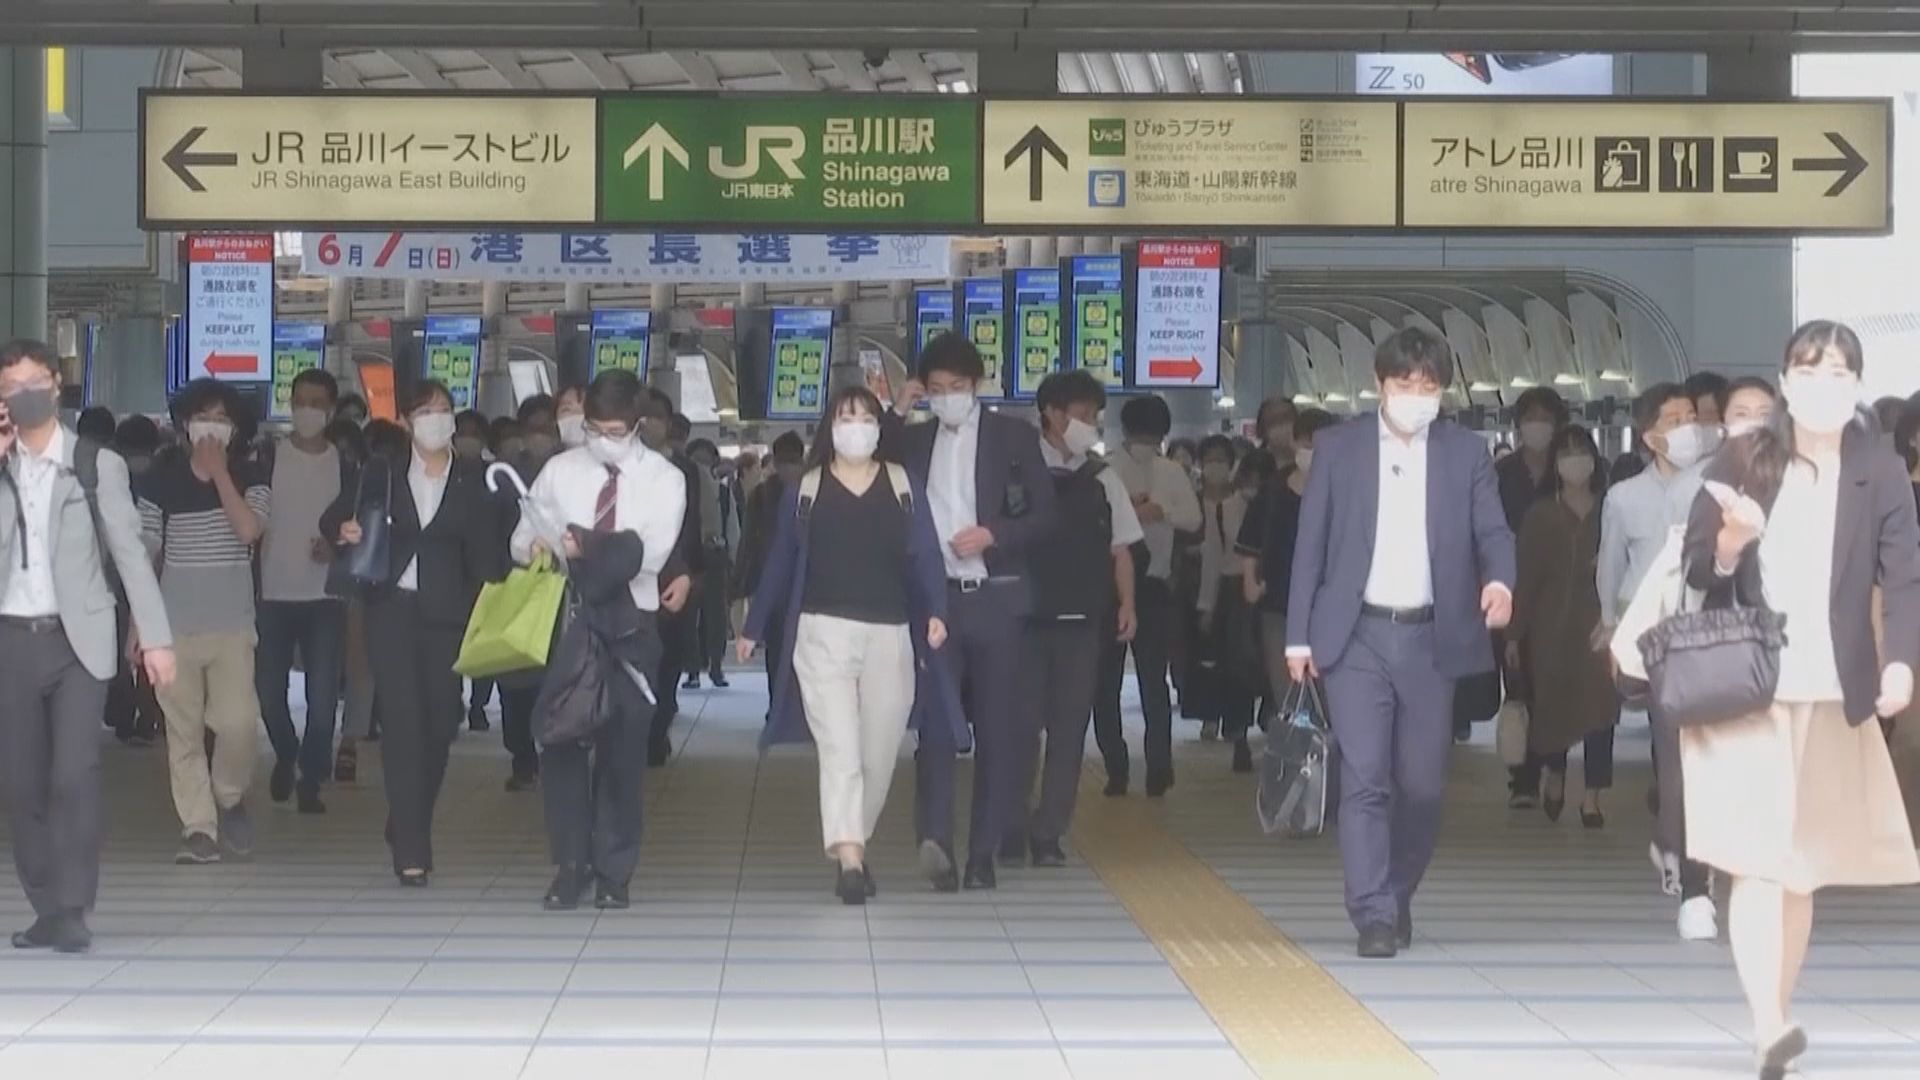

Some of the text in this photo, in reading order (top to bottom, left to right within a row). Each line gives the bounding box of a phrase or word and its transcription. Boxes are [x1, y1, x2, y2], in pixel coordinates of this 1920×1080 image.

[1403, 73, 1425, 90] 50
[822, 117, 935, 155] 品川駅
[1134, 118, 1235, 137] びゅうプラザ
[251, 131, 571, 165] JR 品川イーストビル
[708, 125, 806, 180] JR
[1223, 141, 1256, 151] Service
[1258, 141, 1288, 151] Center
[1430, 137, 1584, 169] アトレ品川
[251, 170, 526, 194] JR Shinagawa East Building
[823, 161, 950, 185] Shinagawa
[721, 182, 794, 199] JR東日本
[1430, 176, 1582, 197] atre Shinagawa
[823, 187, 905, 208] Station
[214, 251, 247, 260] NOTICE
[1163, 257, 1195, 266] NOTICE
[205, 324, 255, 335] KEEP LEFT
[1150, 330, 1205, 340] KEEP RIGHT
